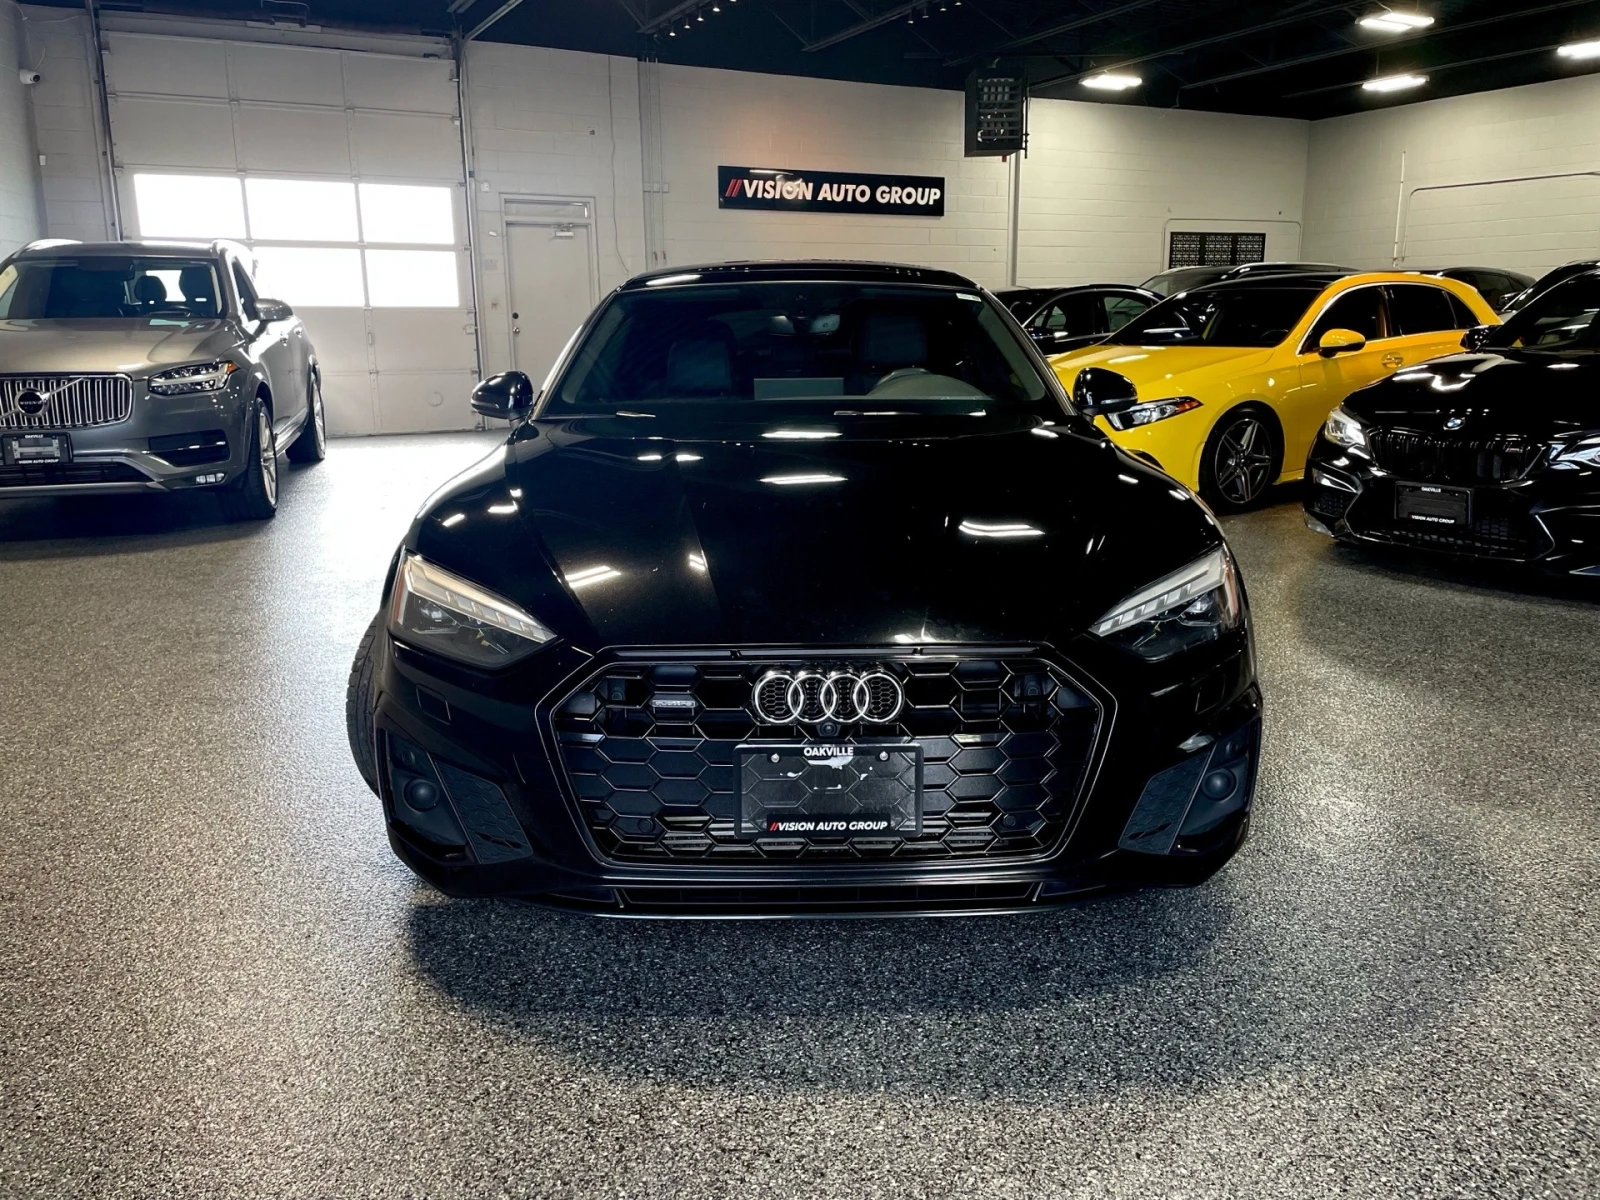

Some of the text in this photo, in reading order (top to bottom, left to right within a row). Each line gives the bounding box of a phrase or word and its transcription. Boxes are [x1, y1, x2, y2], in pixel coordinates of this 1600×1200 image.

[817, 184, 871, 203] AUTO
[875, 186, 941, 205] GROUP
[803, 747, 854, 757] OAKVILLE
[816, 821, 847, 831] AUTO
[848, 821, 888, 831] GROUP
